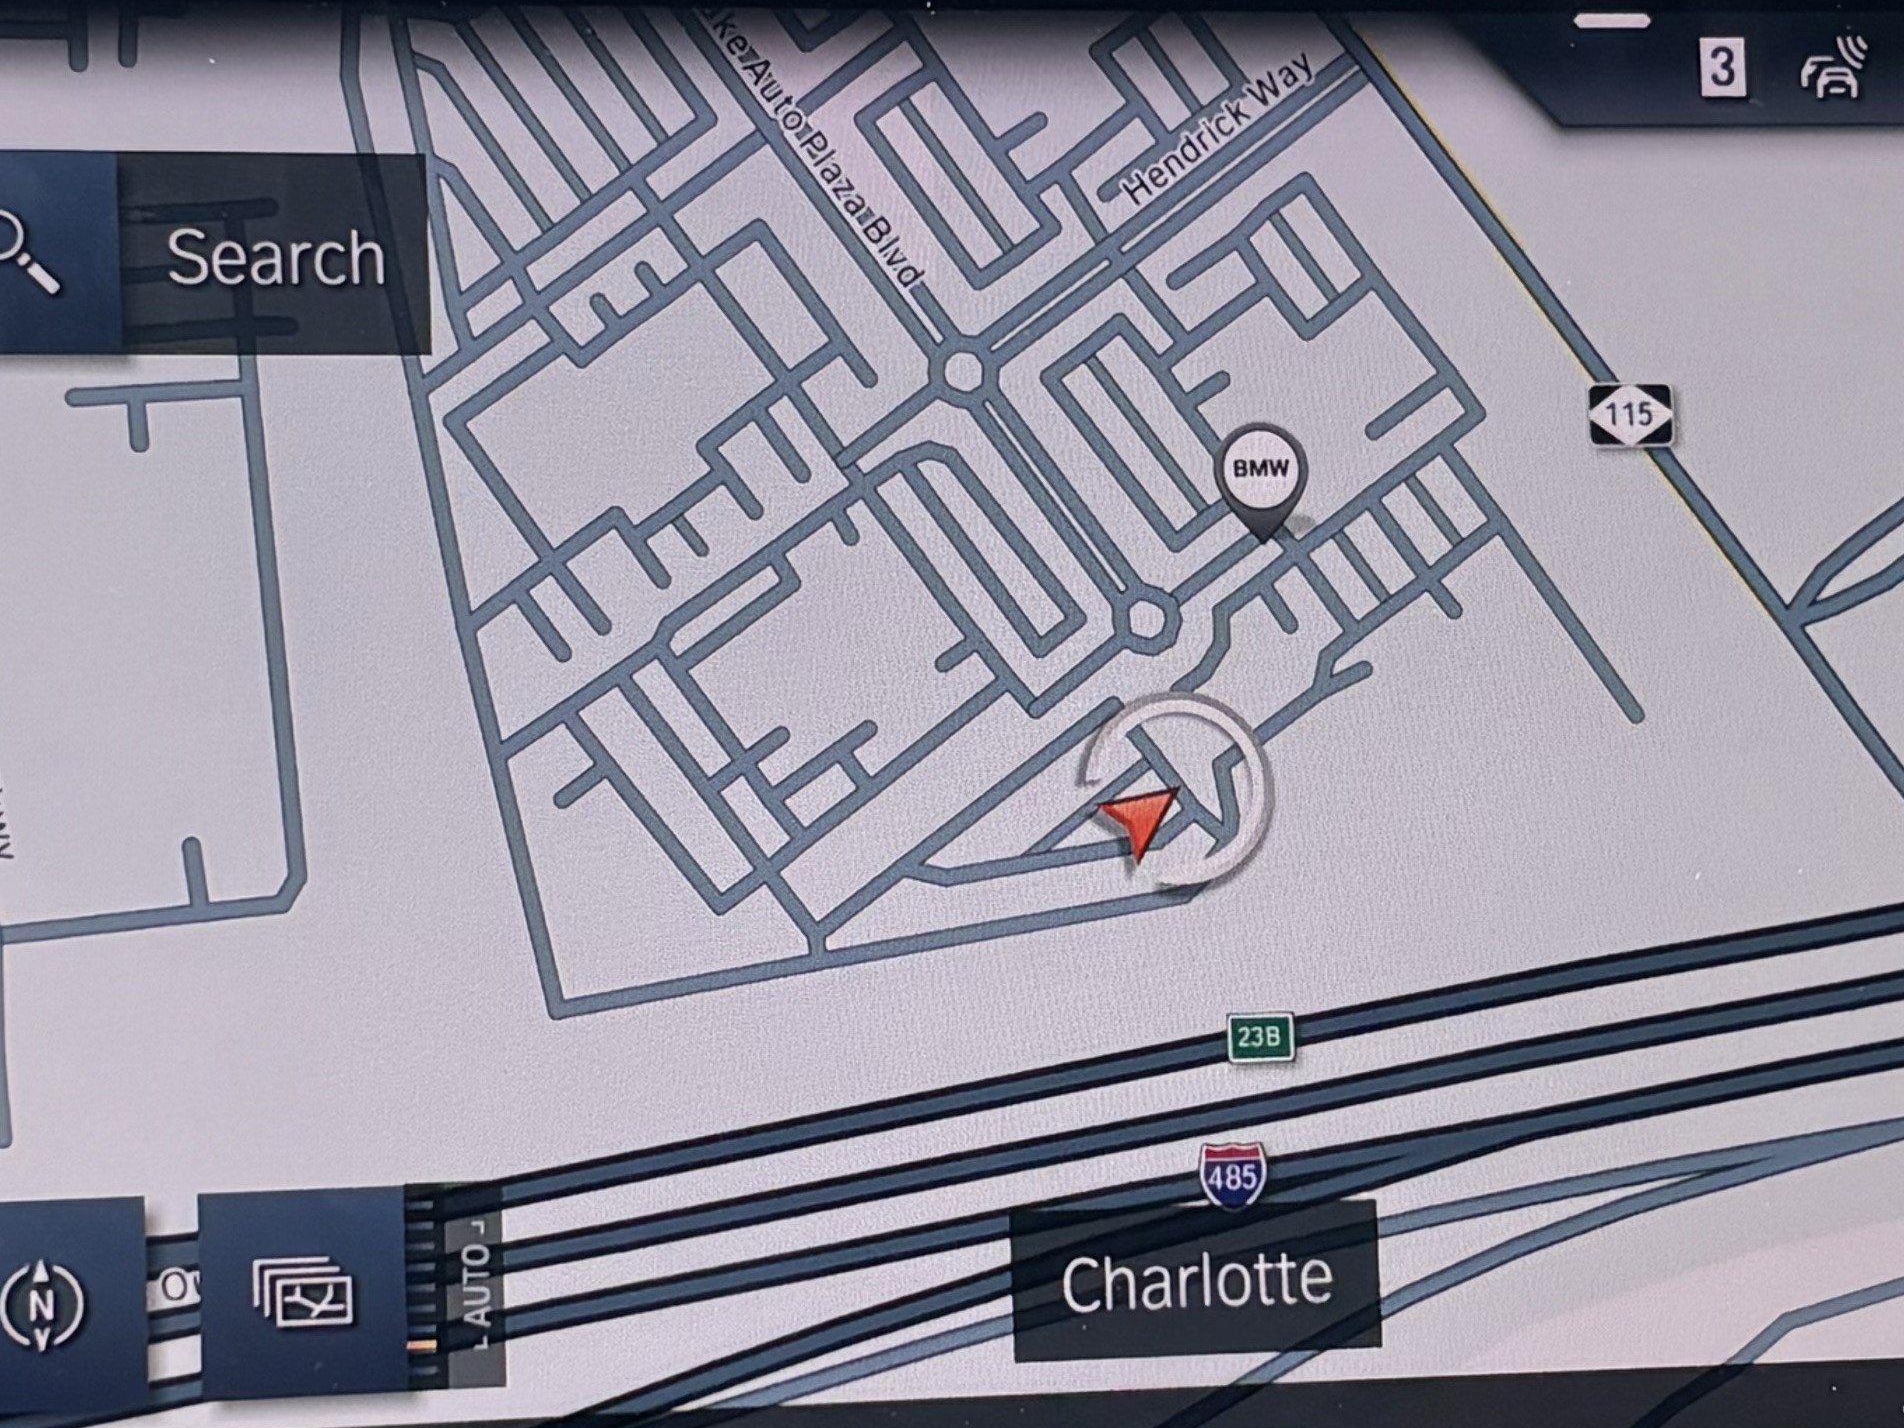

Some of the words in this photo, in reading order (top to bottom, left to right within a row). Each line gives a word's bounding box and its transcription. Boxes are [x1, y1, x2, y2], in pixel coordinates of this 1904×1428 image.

[1710, 45, 1736, 87] 3
[1122, 102, 1251, 206] Hendrick
[1246, 52, 1314, 107] Way
[742, 59, 803, 131] Auto
[799, 130, 866, 217] Plaza
[862, 216, 926, 289] Blvd
[167, 226, 386, 286] Search
[1605, 400, 1653, 427] 115
[1233, 458, 1290, 478] BMW
[1237, 1026, 1281, 1048] 23B
[1208, 1163, 1258, 1191] 485
[461, 1243, 492, 1328] AUTO
[1062, 1250, 1334, 1314] Charlotte
[29, 1289, 54, 1322] N
